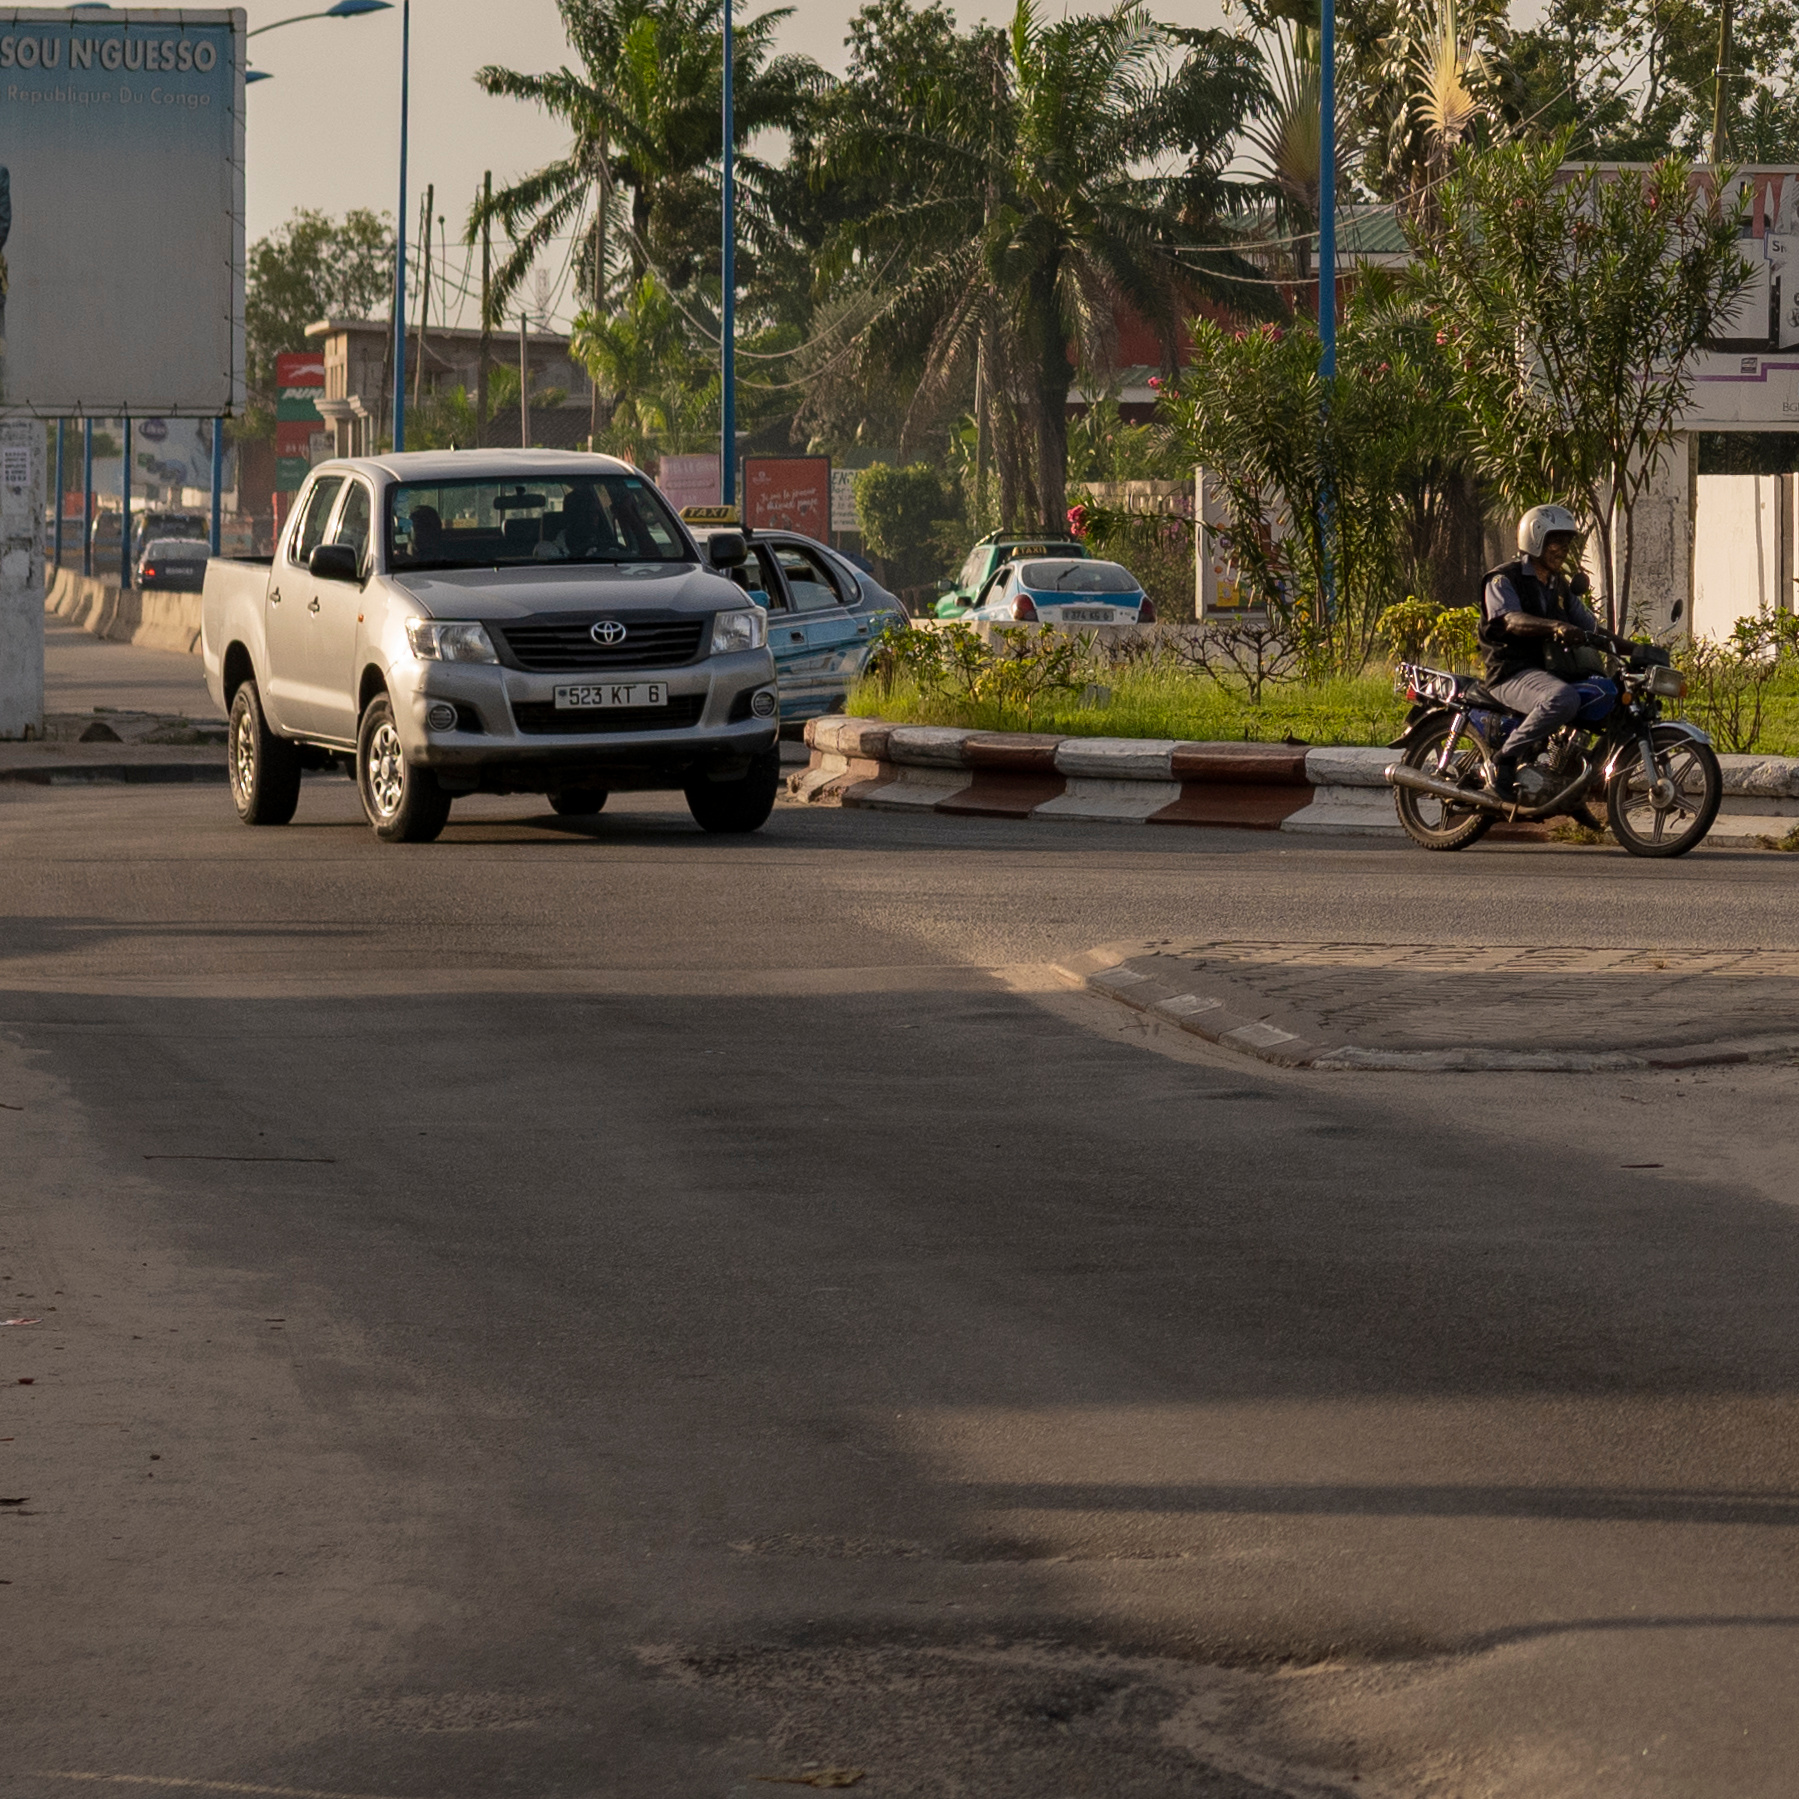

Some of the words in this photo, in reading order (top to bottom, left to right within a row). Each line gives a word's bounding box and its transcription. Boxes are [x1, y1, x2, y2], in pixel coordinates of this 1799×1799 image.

[70, 38, 217, 72] N'GUESSO
[119, 87, 143, 104] Du
[151, 87, 210, 109] Congo
[689, 507, 729, 519] TAXI
[1021, 547, 1044, 555] TAXI
[569, 687, 602, 705] 523
[611, 686, 637, 704] KT
[649, 685, 659, 703] 6
